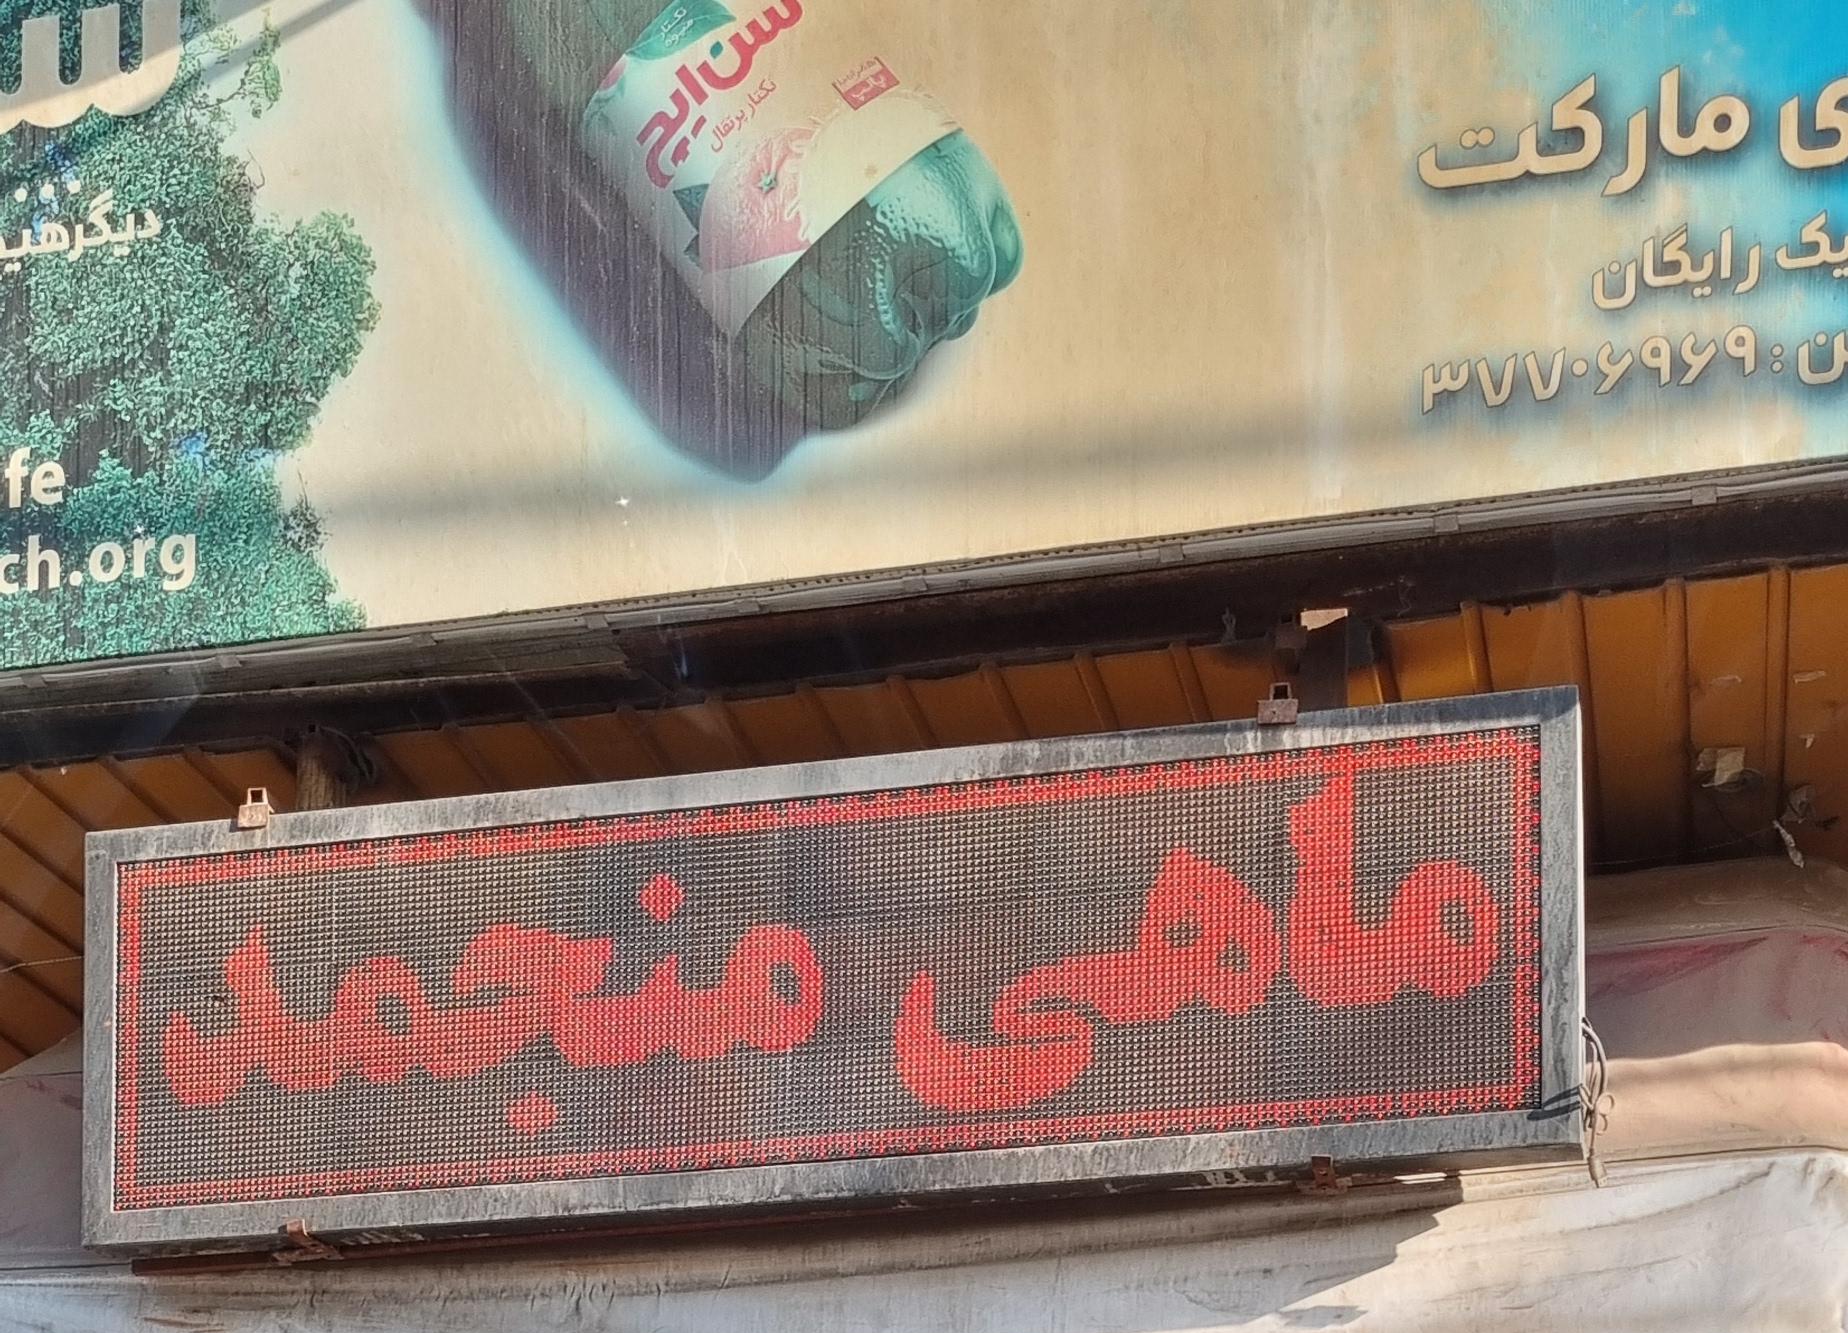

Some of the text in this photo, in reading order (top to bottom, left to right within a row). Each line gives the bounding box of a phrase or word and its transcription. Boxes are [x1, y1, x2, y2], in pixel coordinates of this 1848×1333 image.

[1416, 64, 1751, 198] مارکت
[1592, 222, 1762, 311] رایگان
[1421, 324, 1758, 415] ۳۷۷۰۶۹۶۹
[3, 446, 66, 509] fe
[0, 533, 197, 595] ch.org
[162, 747, 1499, 1135] ماهی منجمد
